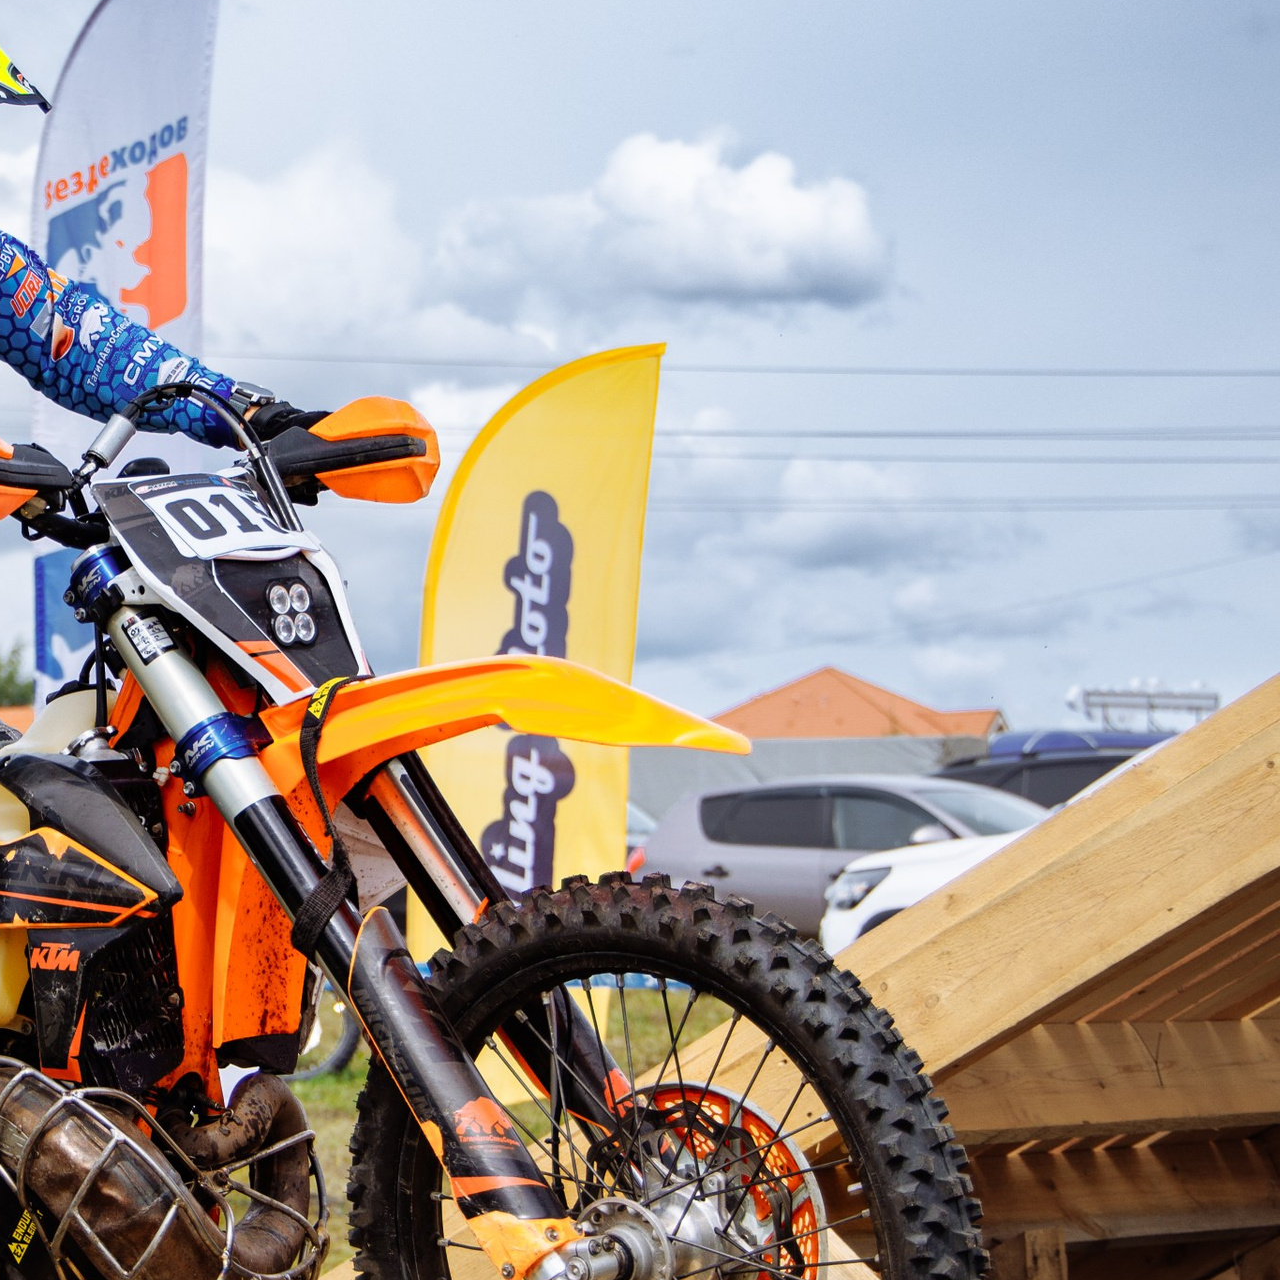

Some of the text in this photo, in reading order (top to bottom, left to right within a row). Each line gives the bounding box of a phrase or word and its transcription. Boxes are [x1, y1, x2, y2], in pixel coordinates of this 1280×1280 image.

[11, 273, 43, 318] ULTRA
[507, 511, 555, 655] oto
[491, 748, 556, 903] ling
[30, 942, 81, 972] KTM
